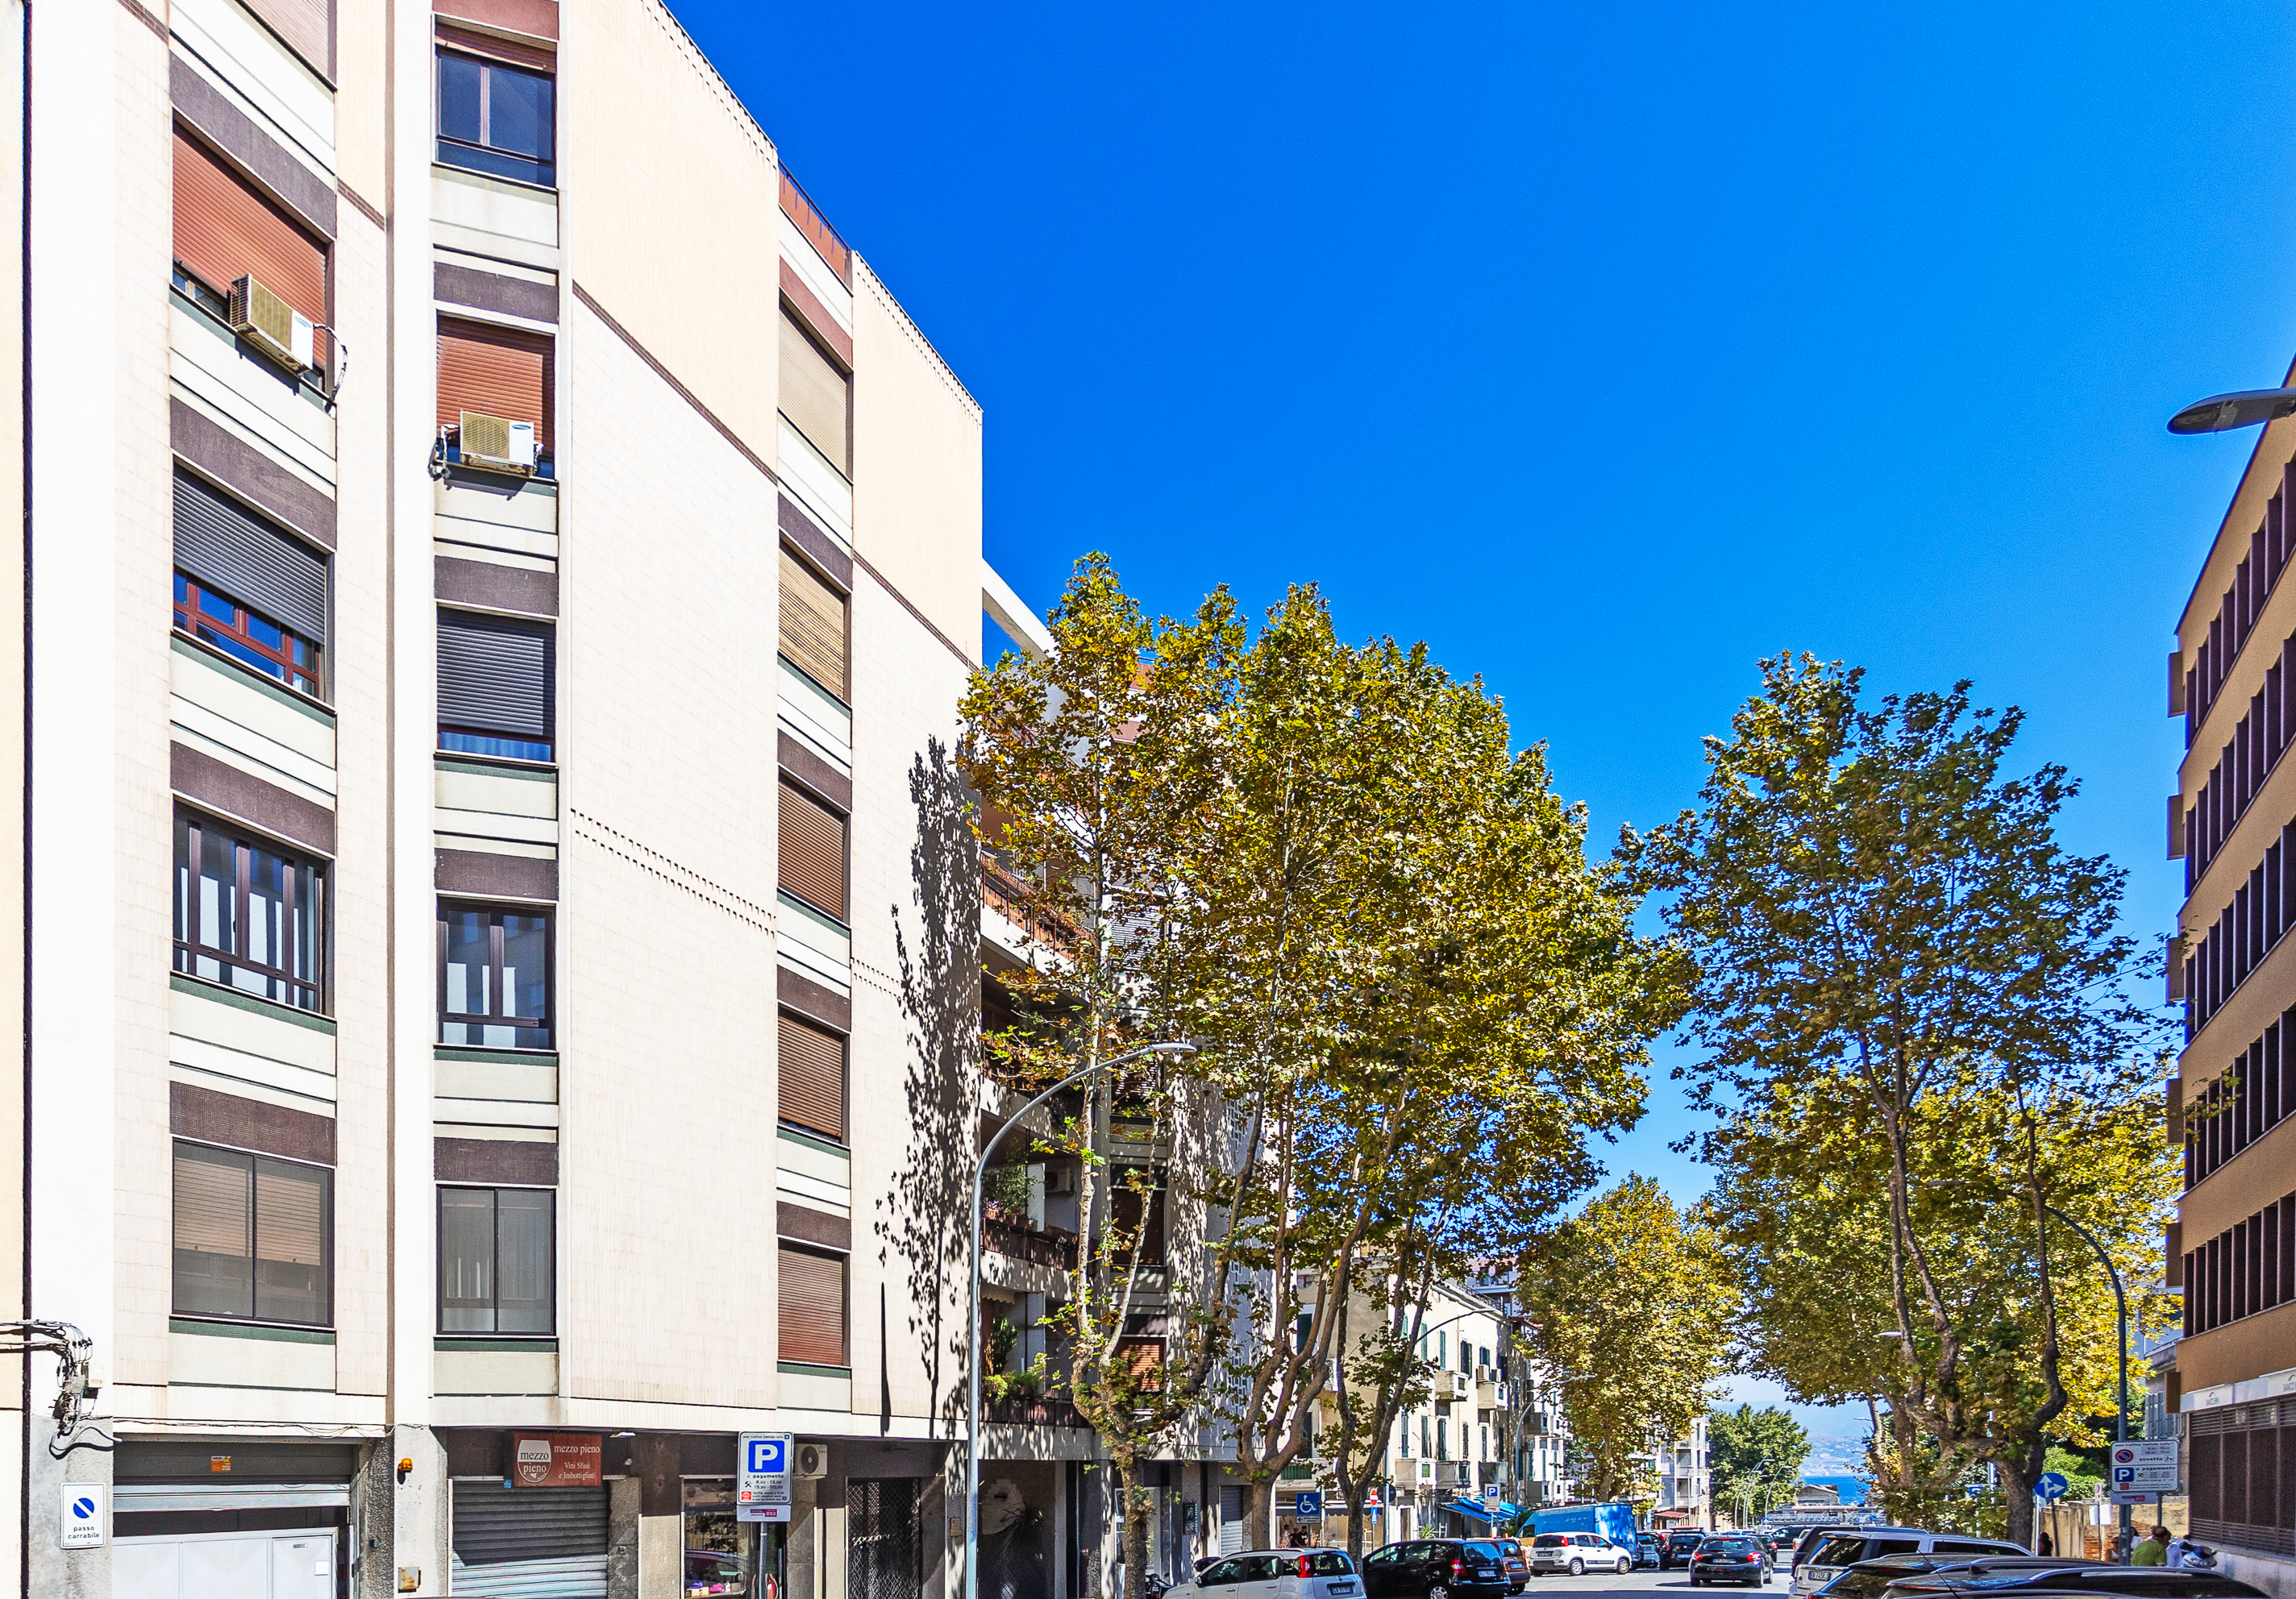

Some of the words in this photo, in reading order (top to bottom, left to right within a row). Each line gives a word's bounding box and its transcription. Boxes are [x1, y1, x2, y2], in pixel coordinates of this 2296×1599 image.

[554, 1445, 579, 1453] mezzo
[580, 1443, 601, 1456] pieno
[520, 1452, 549, 1460] mezzo
[755, 1444, 778, 1469] P
[523, 1462, 547, 1475] pieno
[564, 1472, 596, 1481] Imbottigliati
[2119, 1469, 2130, 1481] P
[1489, 1487, 1496, 1496] P
